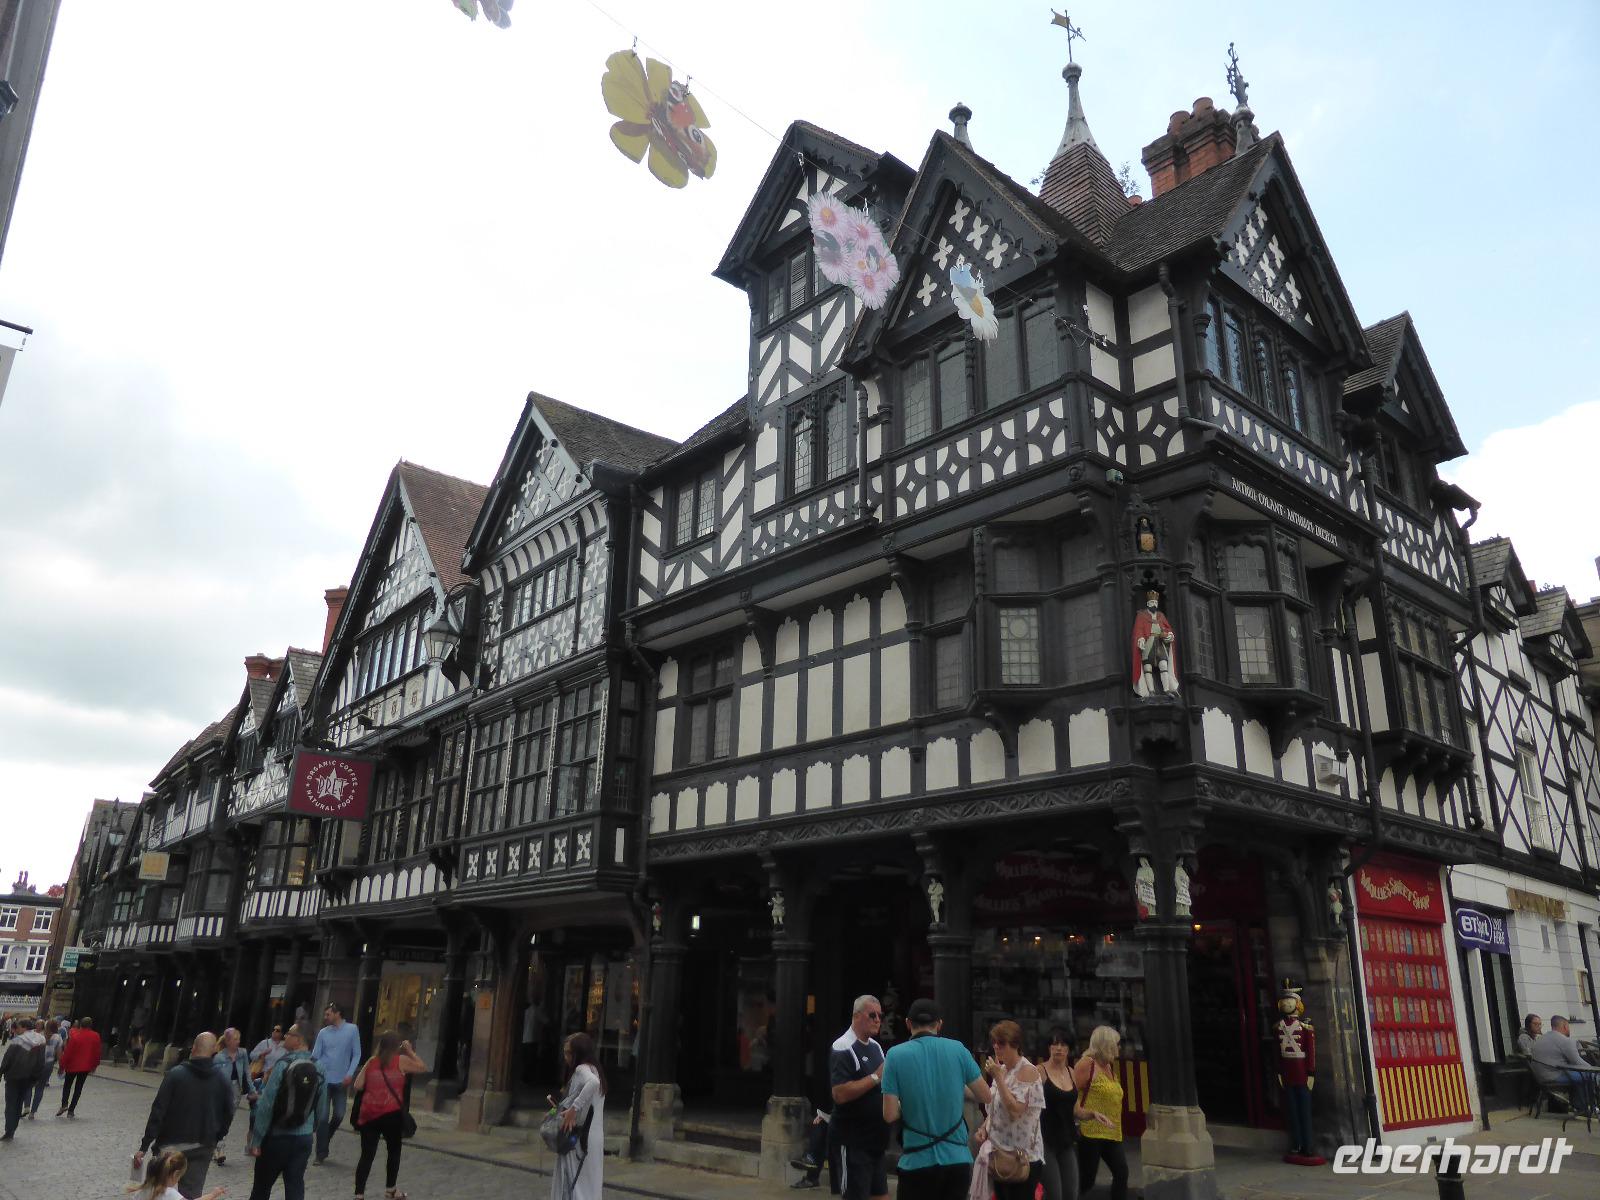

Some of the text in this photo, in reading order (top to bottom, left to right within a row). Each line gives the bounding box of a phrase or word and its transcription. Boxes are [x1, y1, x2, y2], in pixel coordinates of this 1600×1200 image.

[306, 760, 358, 787] ORGANIC COFFEE
[316, 774, 348, 797] PRET
[306, 789, 354, 811] NATURAL FOOD
[1461, 915, 1476, 933] BT
